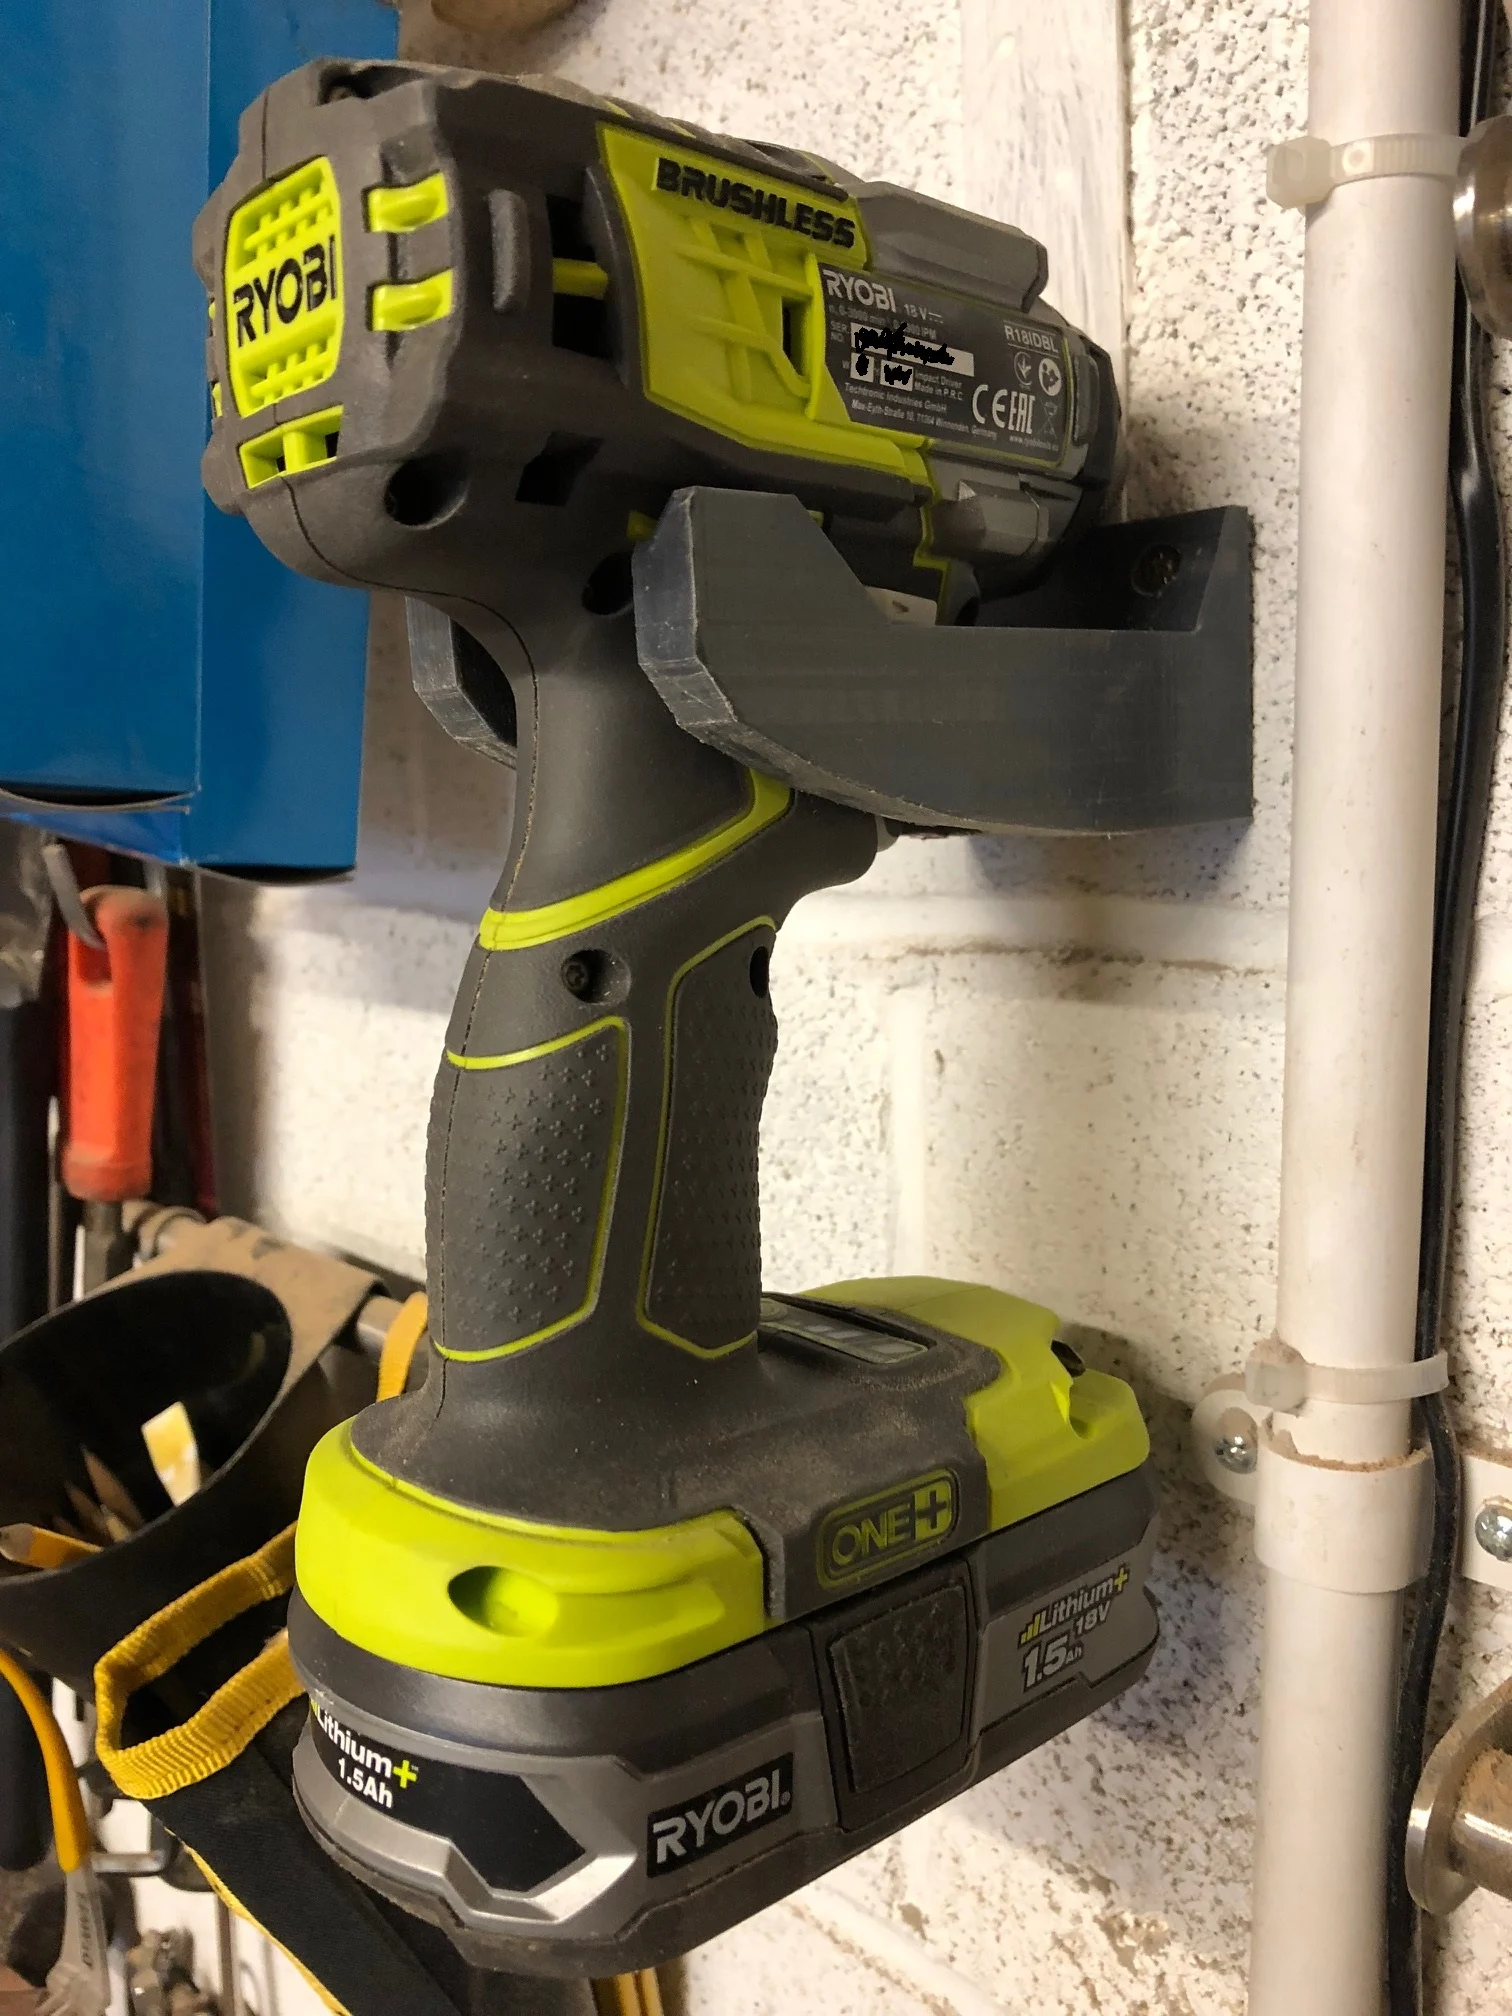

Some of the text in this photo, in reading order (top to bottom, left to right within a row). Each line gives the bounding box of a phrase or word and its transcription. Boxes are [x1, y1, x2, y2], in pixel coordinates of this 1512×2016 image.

[657, 158, 855, 248] BRUSHLESS
[233, 233, 337, 348] RYOBI
[823, 269, 896, 313] RYOBI
[1004, 325, 1059, 353] R18IDBL
[1076, 1600, 1111, 1635] 18V
[338, 1758, 393, 1808] 1.5Ah
